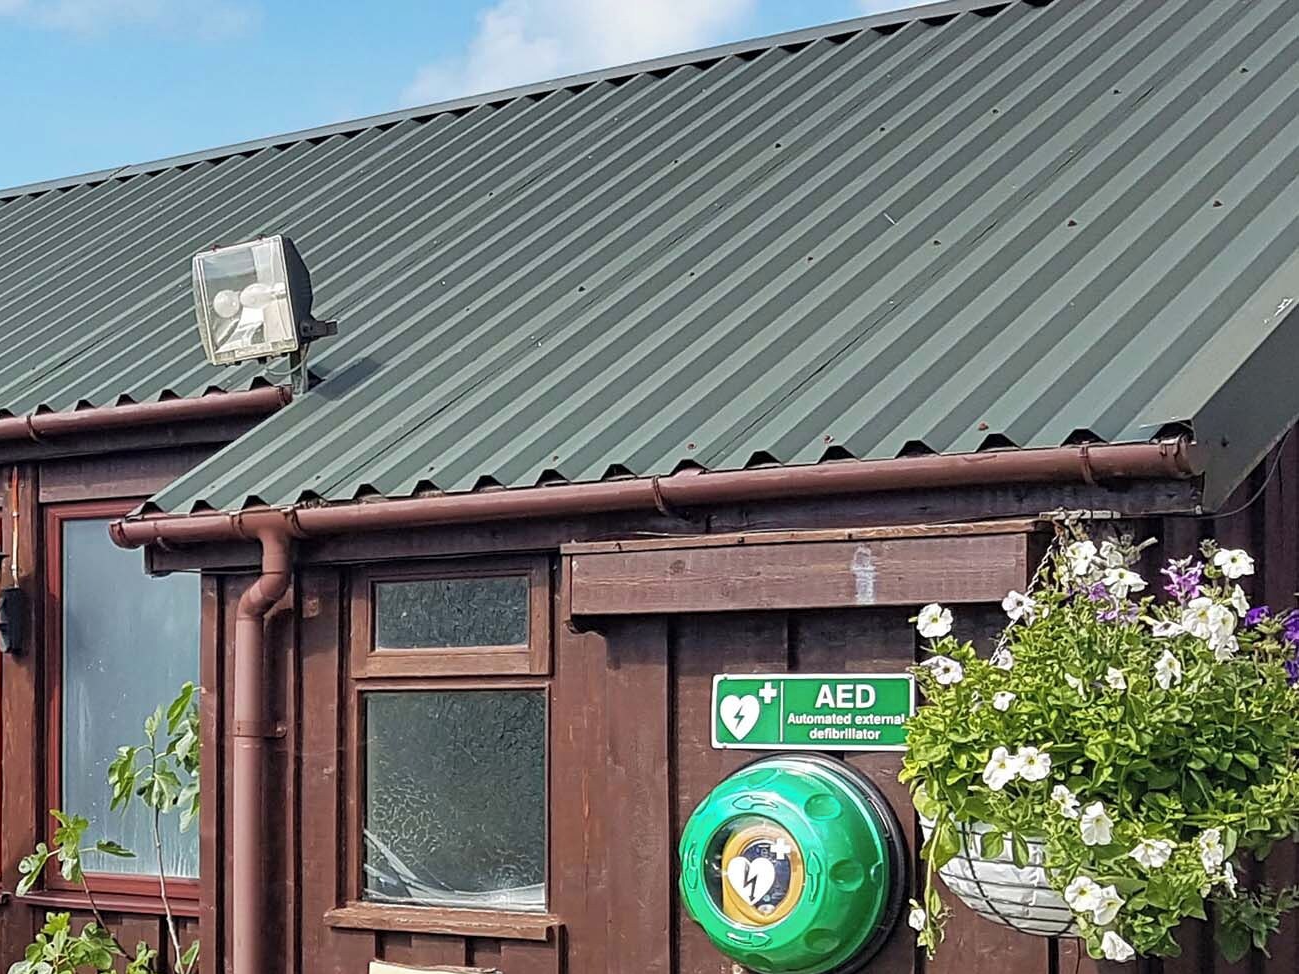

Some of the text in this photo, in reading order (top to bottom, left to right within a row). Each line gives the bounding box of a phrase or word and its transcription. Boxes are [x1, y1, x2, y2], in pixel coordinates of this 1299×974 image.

[814, 683, 877, 709] AED
[787, 713, 906, 726] Automated external
[808, 727, 882, 741] defibrillator
